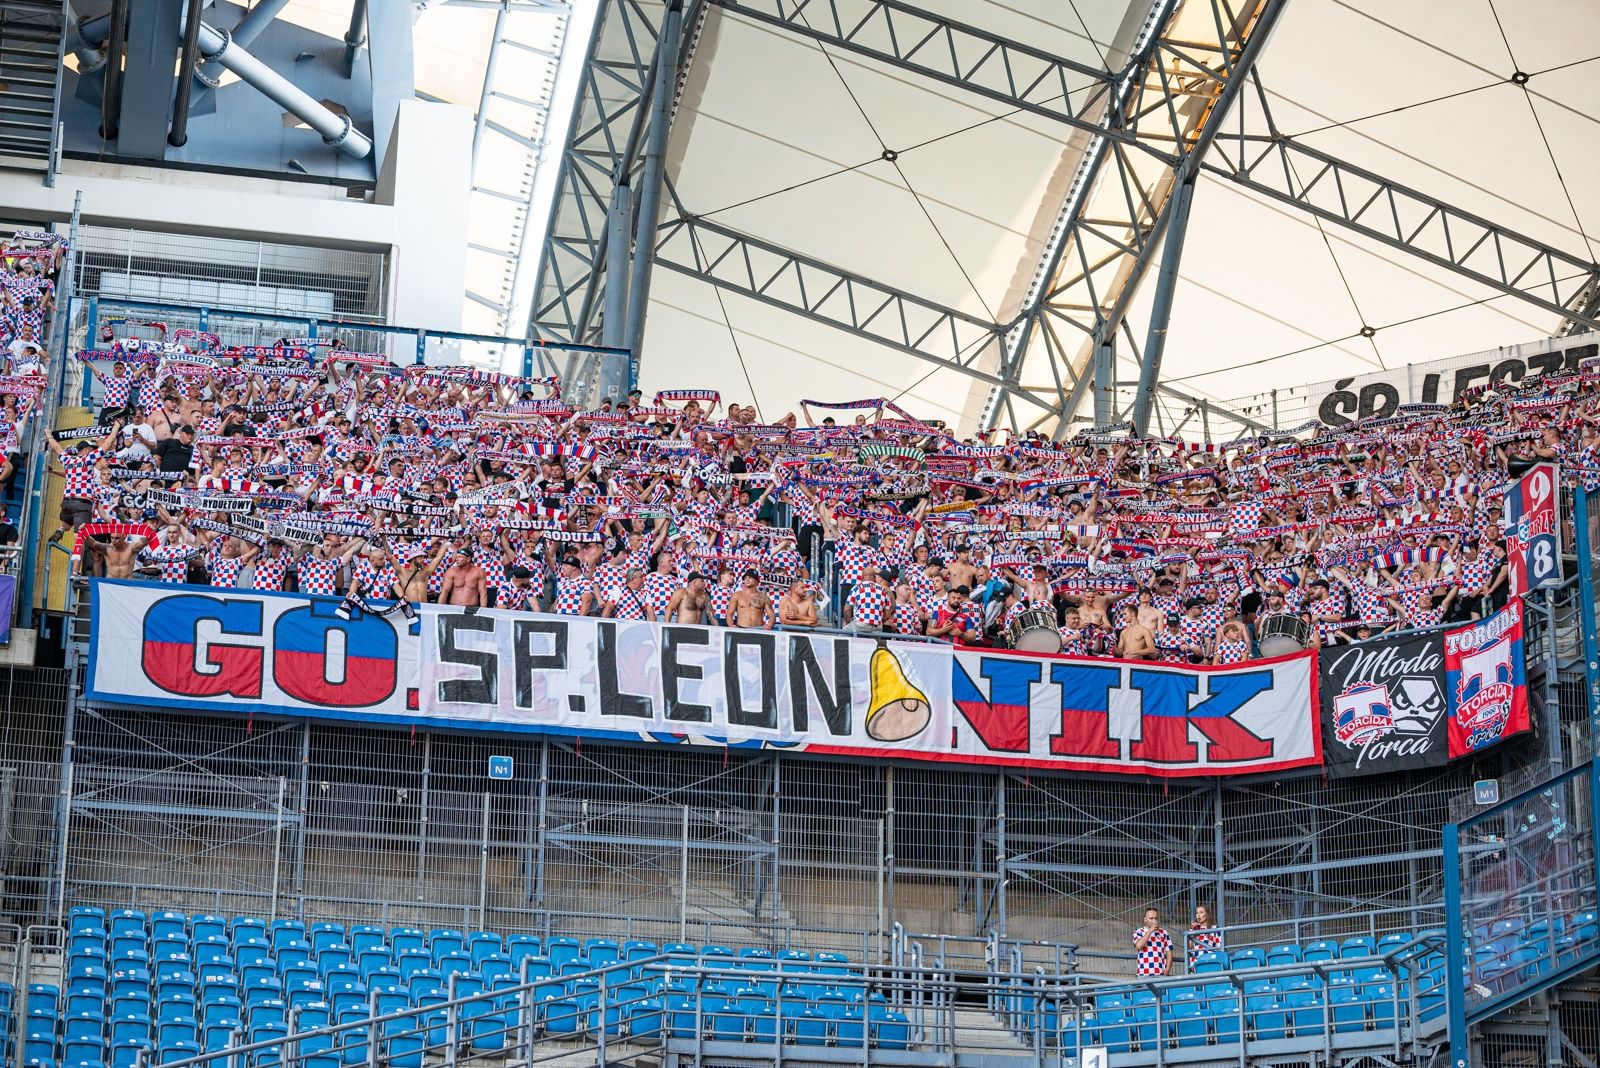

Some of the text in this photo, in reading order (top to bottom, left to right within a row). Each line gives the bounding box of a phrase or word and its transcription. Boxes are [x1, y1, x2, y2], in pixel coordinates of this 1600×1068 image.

[165, 353, 214, 366] TORCIDA
[150, 489, 252, 510] TORCIDA RYDUŁTOWY
[1529, 470, 1551, 513] 9
[232, 513, 266, 531] TORCIDA
[500, 519, 562, 531] GODULA
[836, 504, 916, 528] TORCIDA
[543, 531, 601, 543] GODULA
[1533, 539, 1553, 579] 8
[1446, 605, 1521, 656] TORCIDA
[1328, 641, 1444, 688] Młoda
[1463, 686, 1508, 717] TORCIDA
[1340, 715, 1388, 736] TORCIDA
[1346, 726, 1434, 770] Torca
[495, 764, 508, 774] N1
[1479, 790, 1495, 799] M1
